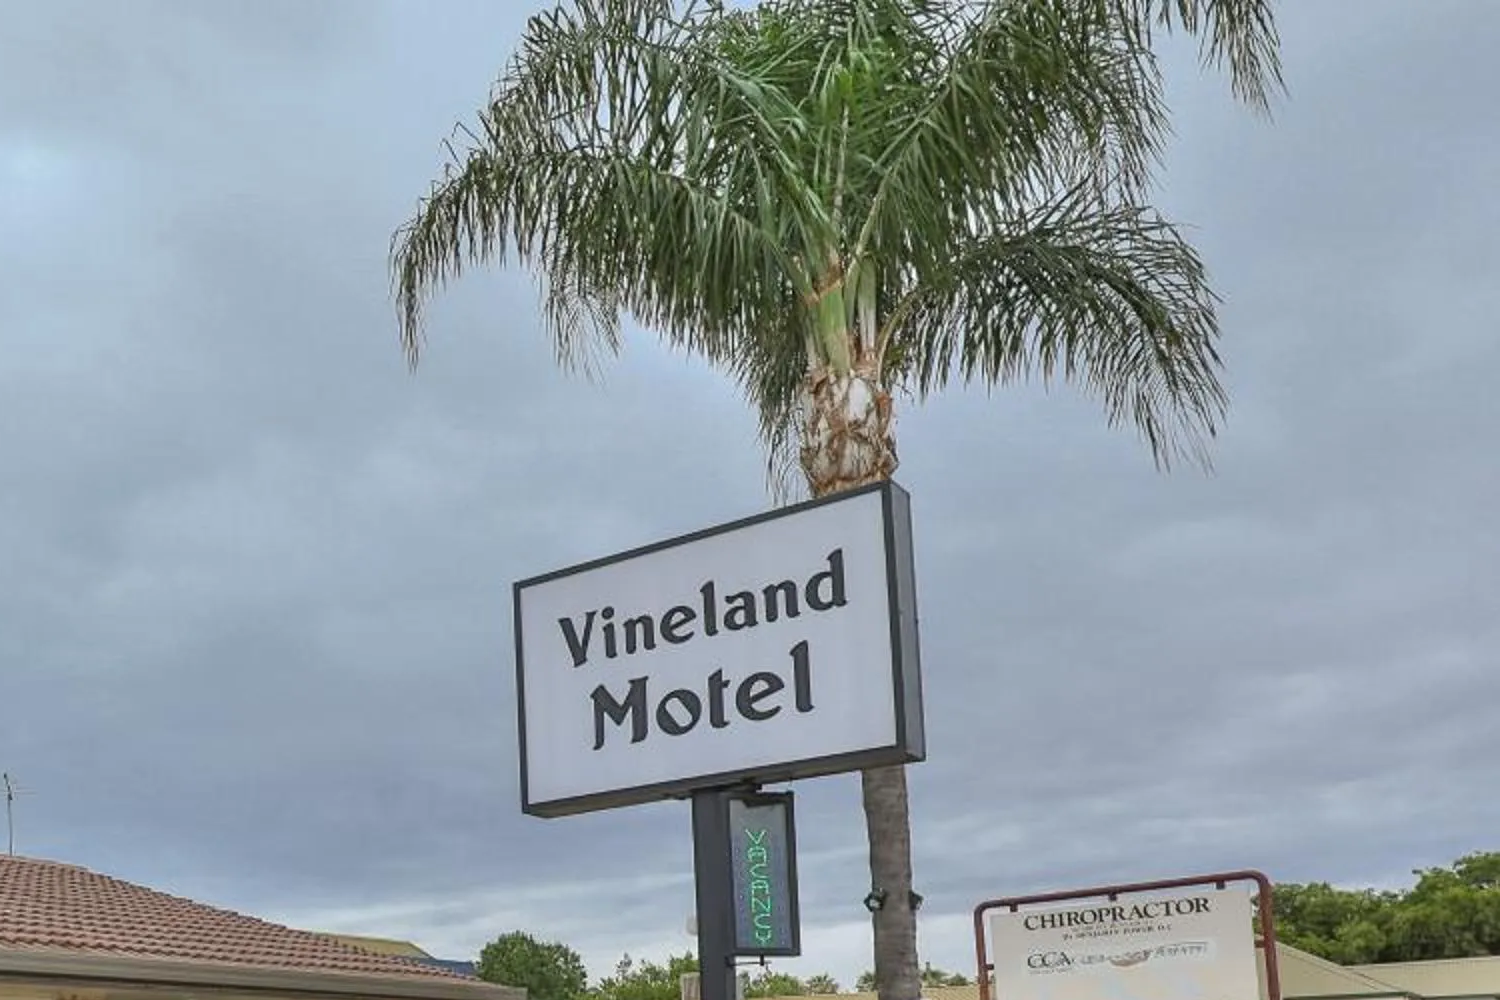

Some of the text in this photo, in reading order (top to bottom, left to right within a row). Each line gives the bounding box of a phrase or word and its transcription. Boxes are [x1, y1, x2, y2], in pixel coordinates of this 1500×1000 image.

[557, 547, 848, 668] Vineland
[589, 639, 815, 751] Motel
[744, 828, 772, 946] VACANCY
[1023, 897, 1212, 931] CHIROPRACTOR
[1026, 951, 1073, 969] CCA
